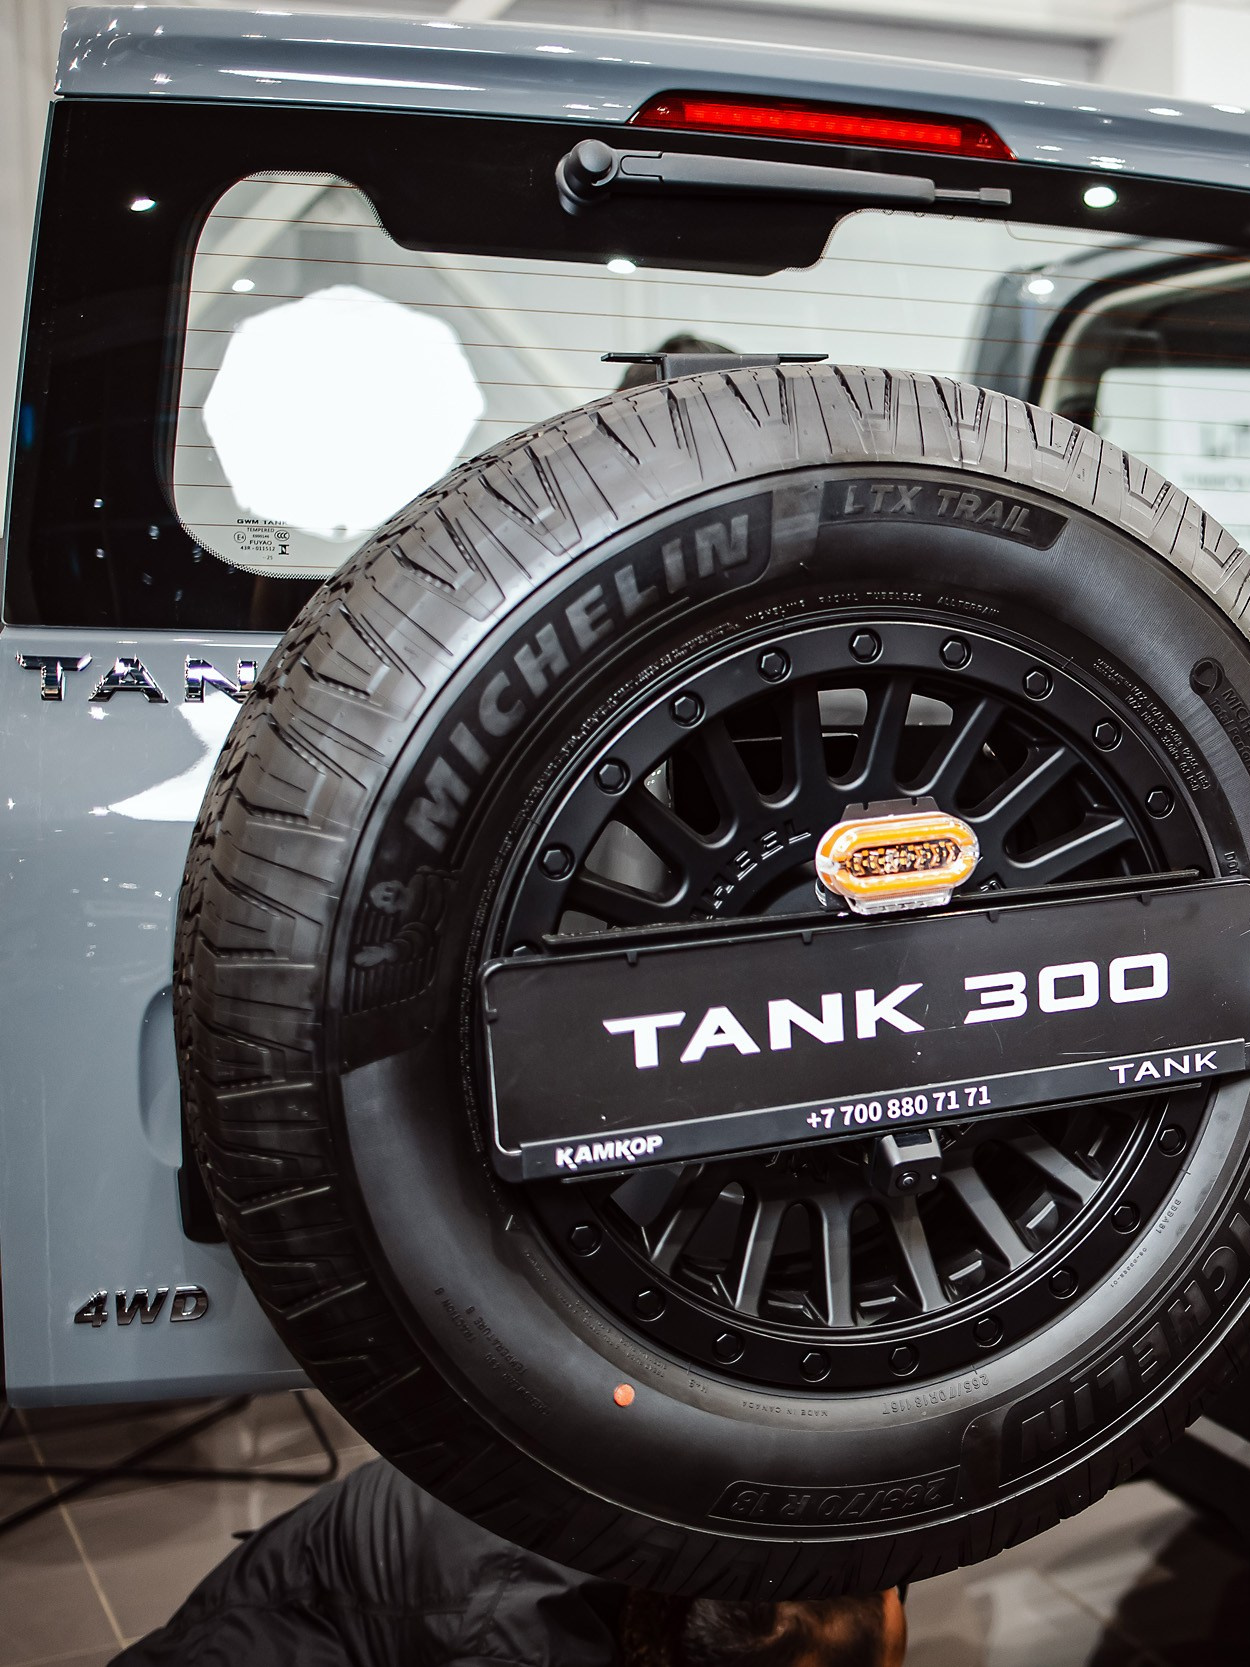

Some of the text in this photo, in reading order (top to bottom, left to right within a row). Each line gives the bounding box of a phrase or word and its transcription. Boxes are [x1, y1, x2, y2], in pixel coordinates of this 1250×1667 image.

[843, 484, 1031, 535] LTX TRAIL
[404, 514, 750, 854] MICHELIN
[602, 951, 1170, 1070] TANK 300
[1108, 1050, 1218, 1084] TANK
[806, 1085, 991, 1129] +7 700 880 71 71
[73, 1284, 209, 1328] 4WD
